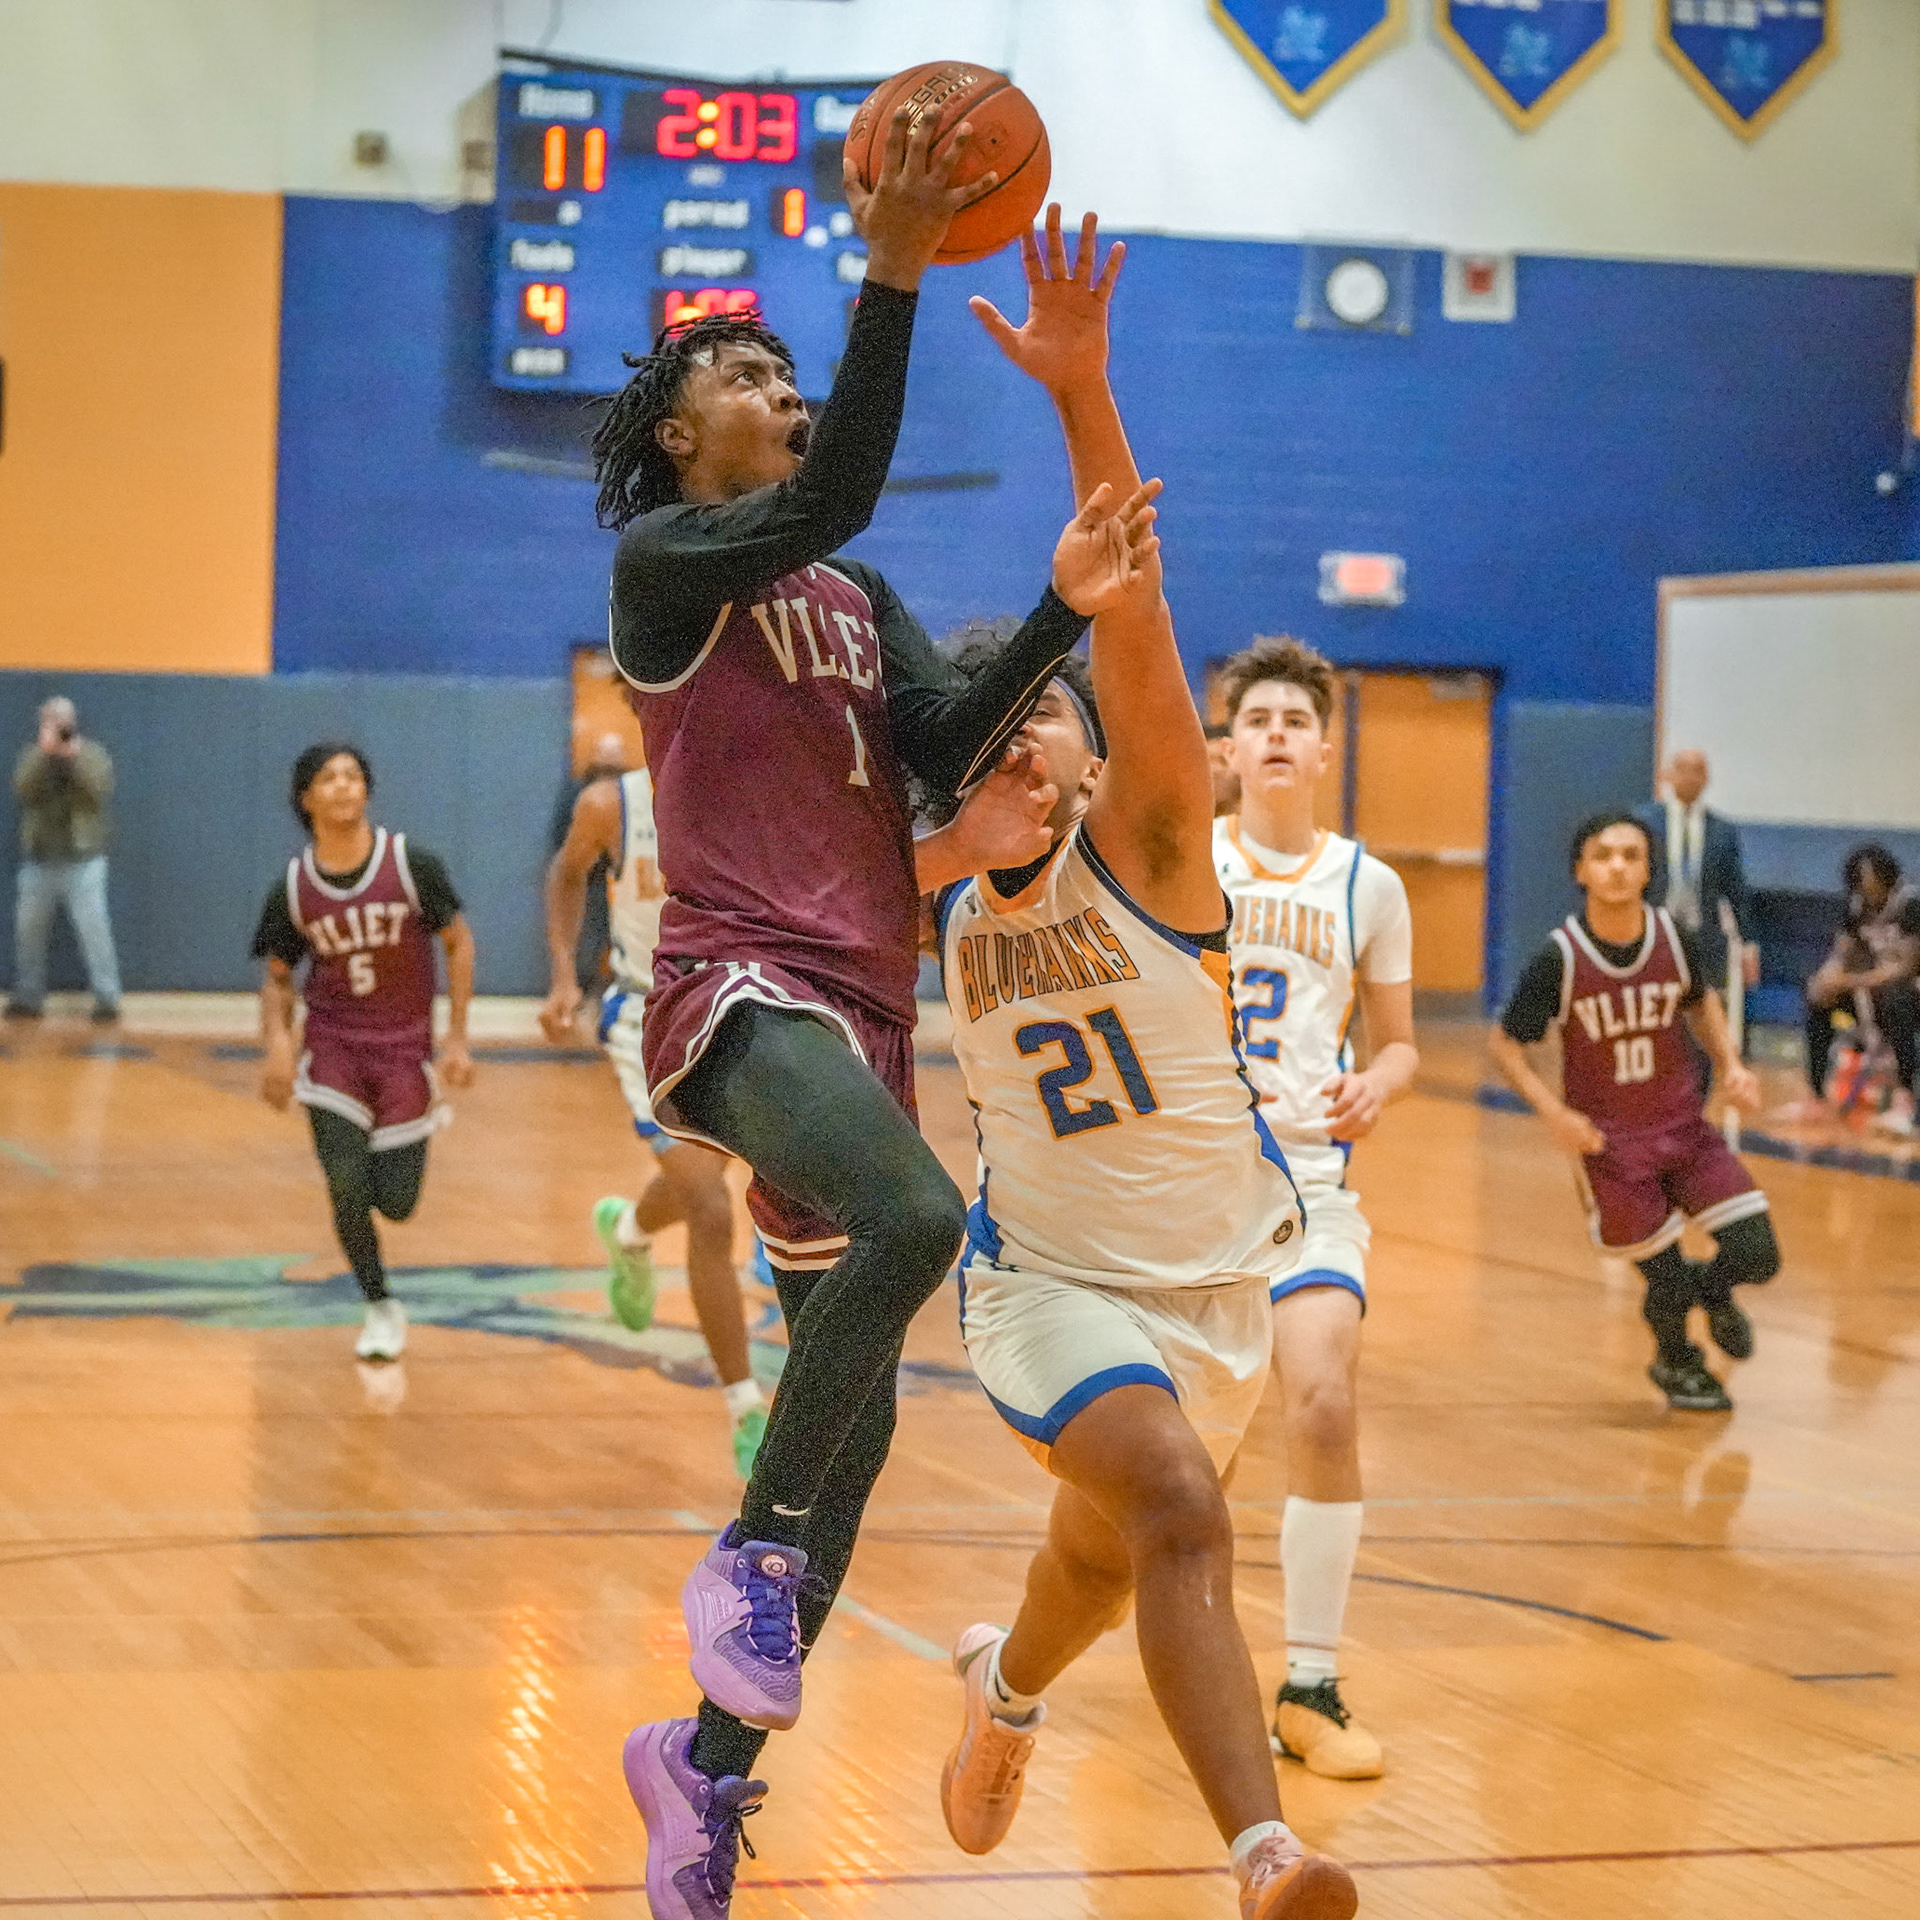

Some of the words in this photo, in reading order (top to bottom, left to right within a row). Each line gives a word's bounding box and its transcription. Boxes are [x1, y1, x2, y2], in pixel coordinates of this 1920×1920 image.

[544, 125, 606, 192] 11
[657, 88, 797, 162] 2:03
[525, 283, 566, 335] 4
[845, 704, 870, 787] 1
[348, 953, 376, 996] 5
[1239, 963, 1289, 1064] 2
[1573, 981, 1682, 1042] VLIET
[1012, 1003, 1161, 1141] 21
[1614, 1036, 1656, 1085] 10
